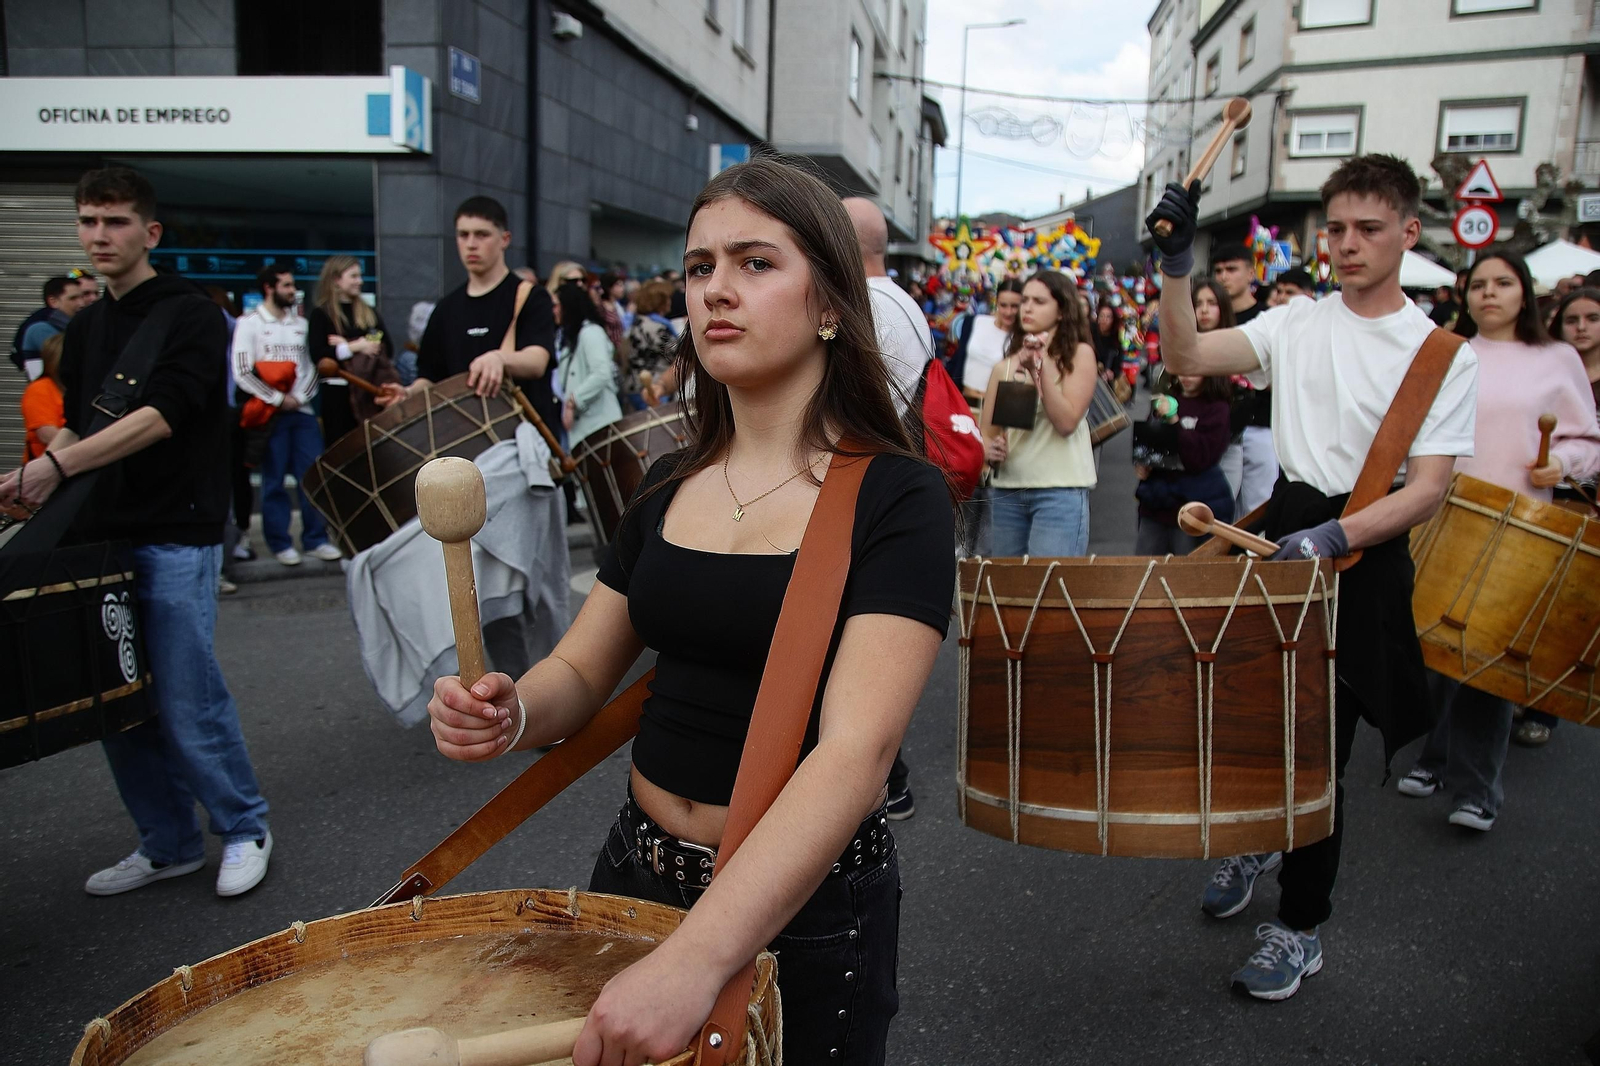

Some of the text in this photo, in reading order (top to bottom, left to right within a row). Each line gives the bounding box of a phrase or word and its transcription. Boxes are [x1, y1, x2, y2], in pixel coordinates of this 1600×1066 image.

[39, 107, 231, 124] OFICINA DE EMPREGO
[1463, 219, 1489, 235] 30
